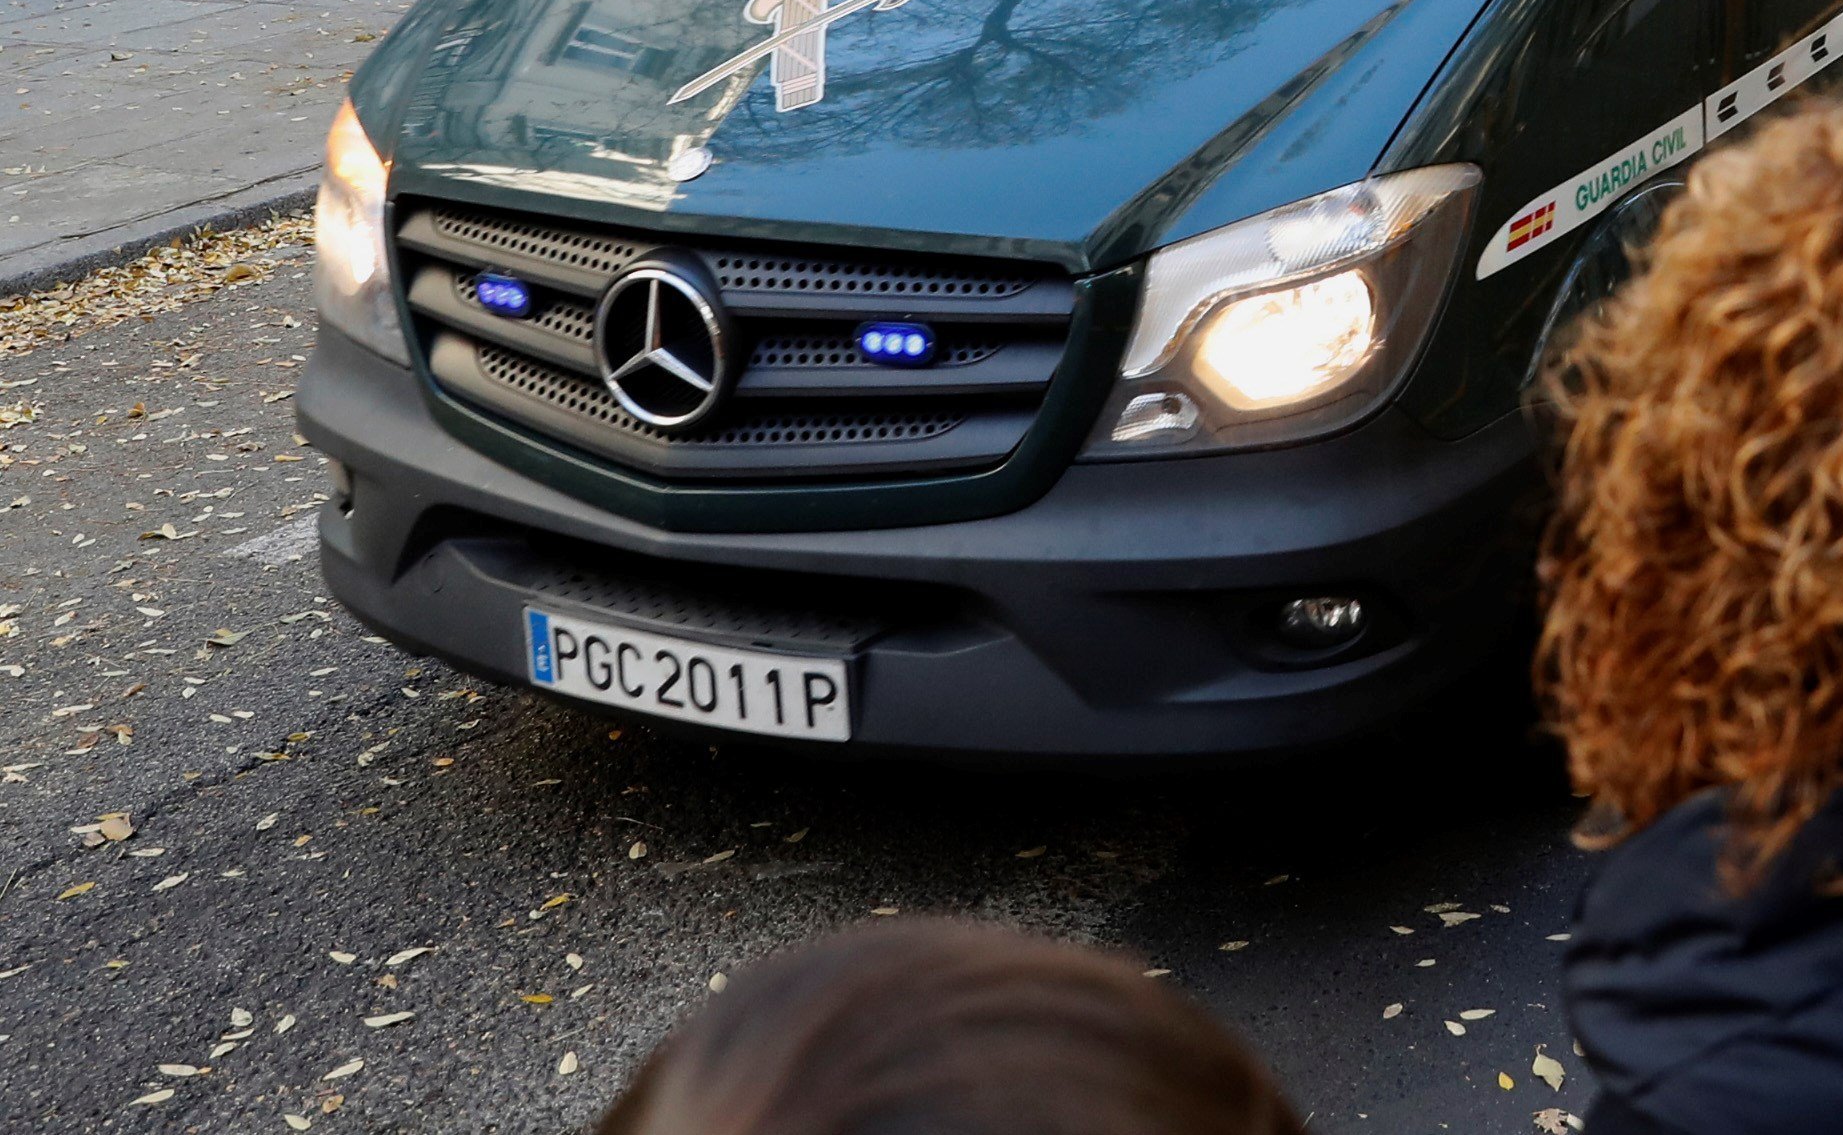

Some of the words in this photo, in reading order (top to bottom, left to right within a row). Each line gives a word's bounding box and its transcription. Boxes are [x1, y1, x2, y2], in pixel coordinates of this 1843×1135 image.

[1575, 150, 1648, 211] GUARDIA
[1652, 126, 1686, 165] CIVIL
[552, 627, 838, 729] PGC2011P
